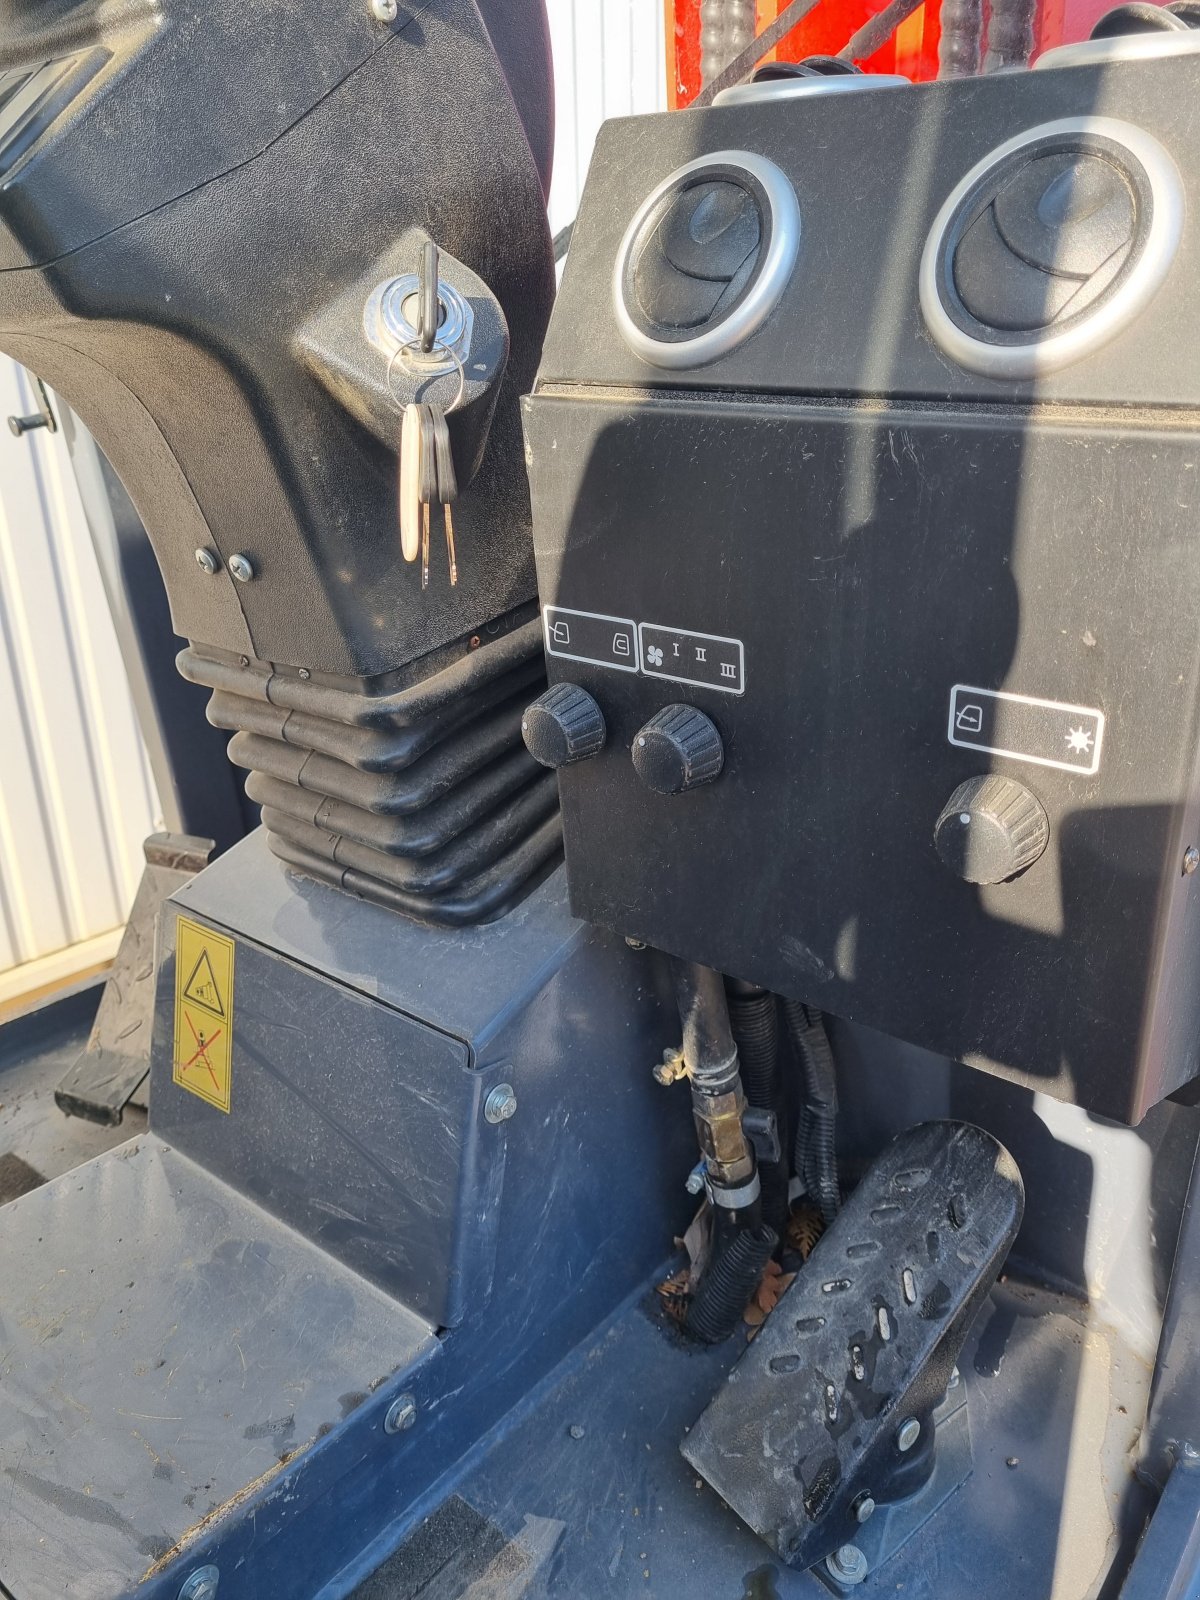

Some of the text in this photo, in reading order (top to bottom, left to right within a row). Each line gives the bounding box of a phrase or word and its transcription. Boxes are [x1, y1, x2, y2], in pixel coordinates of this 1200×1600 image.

[672, 642, 737, 679] I II III
